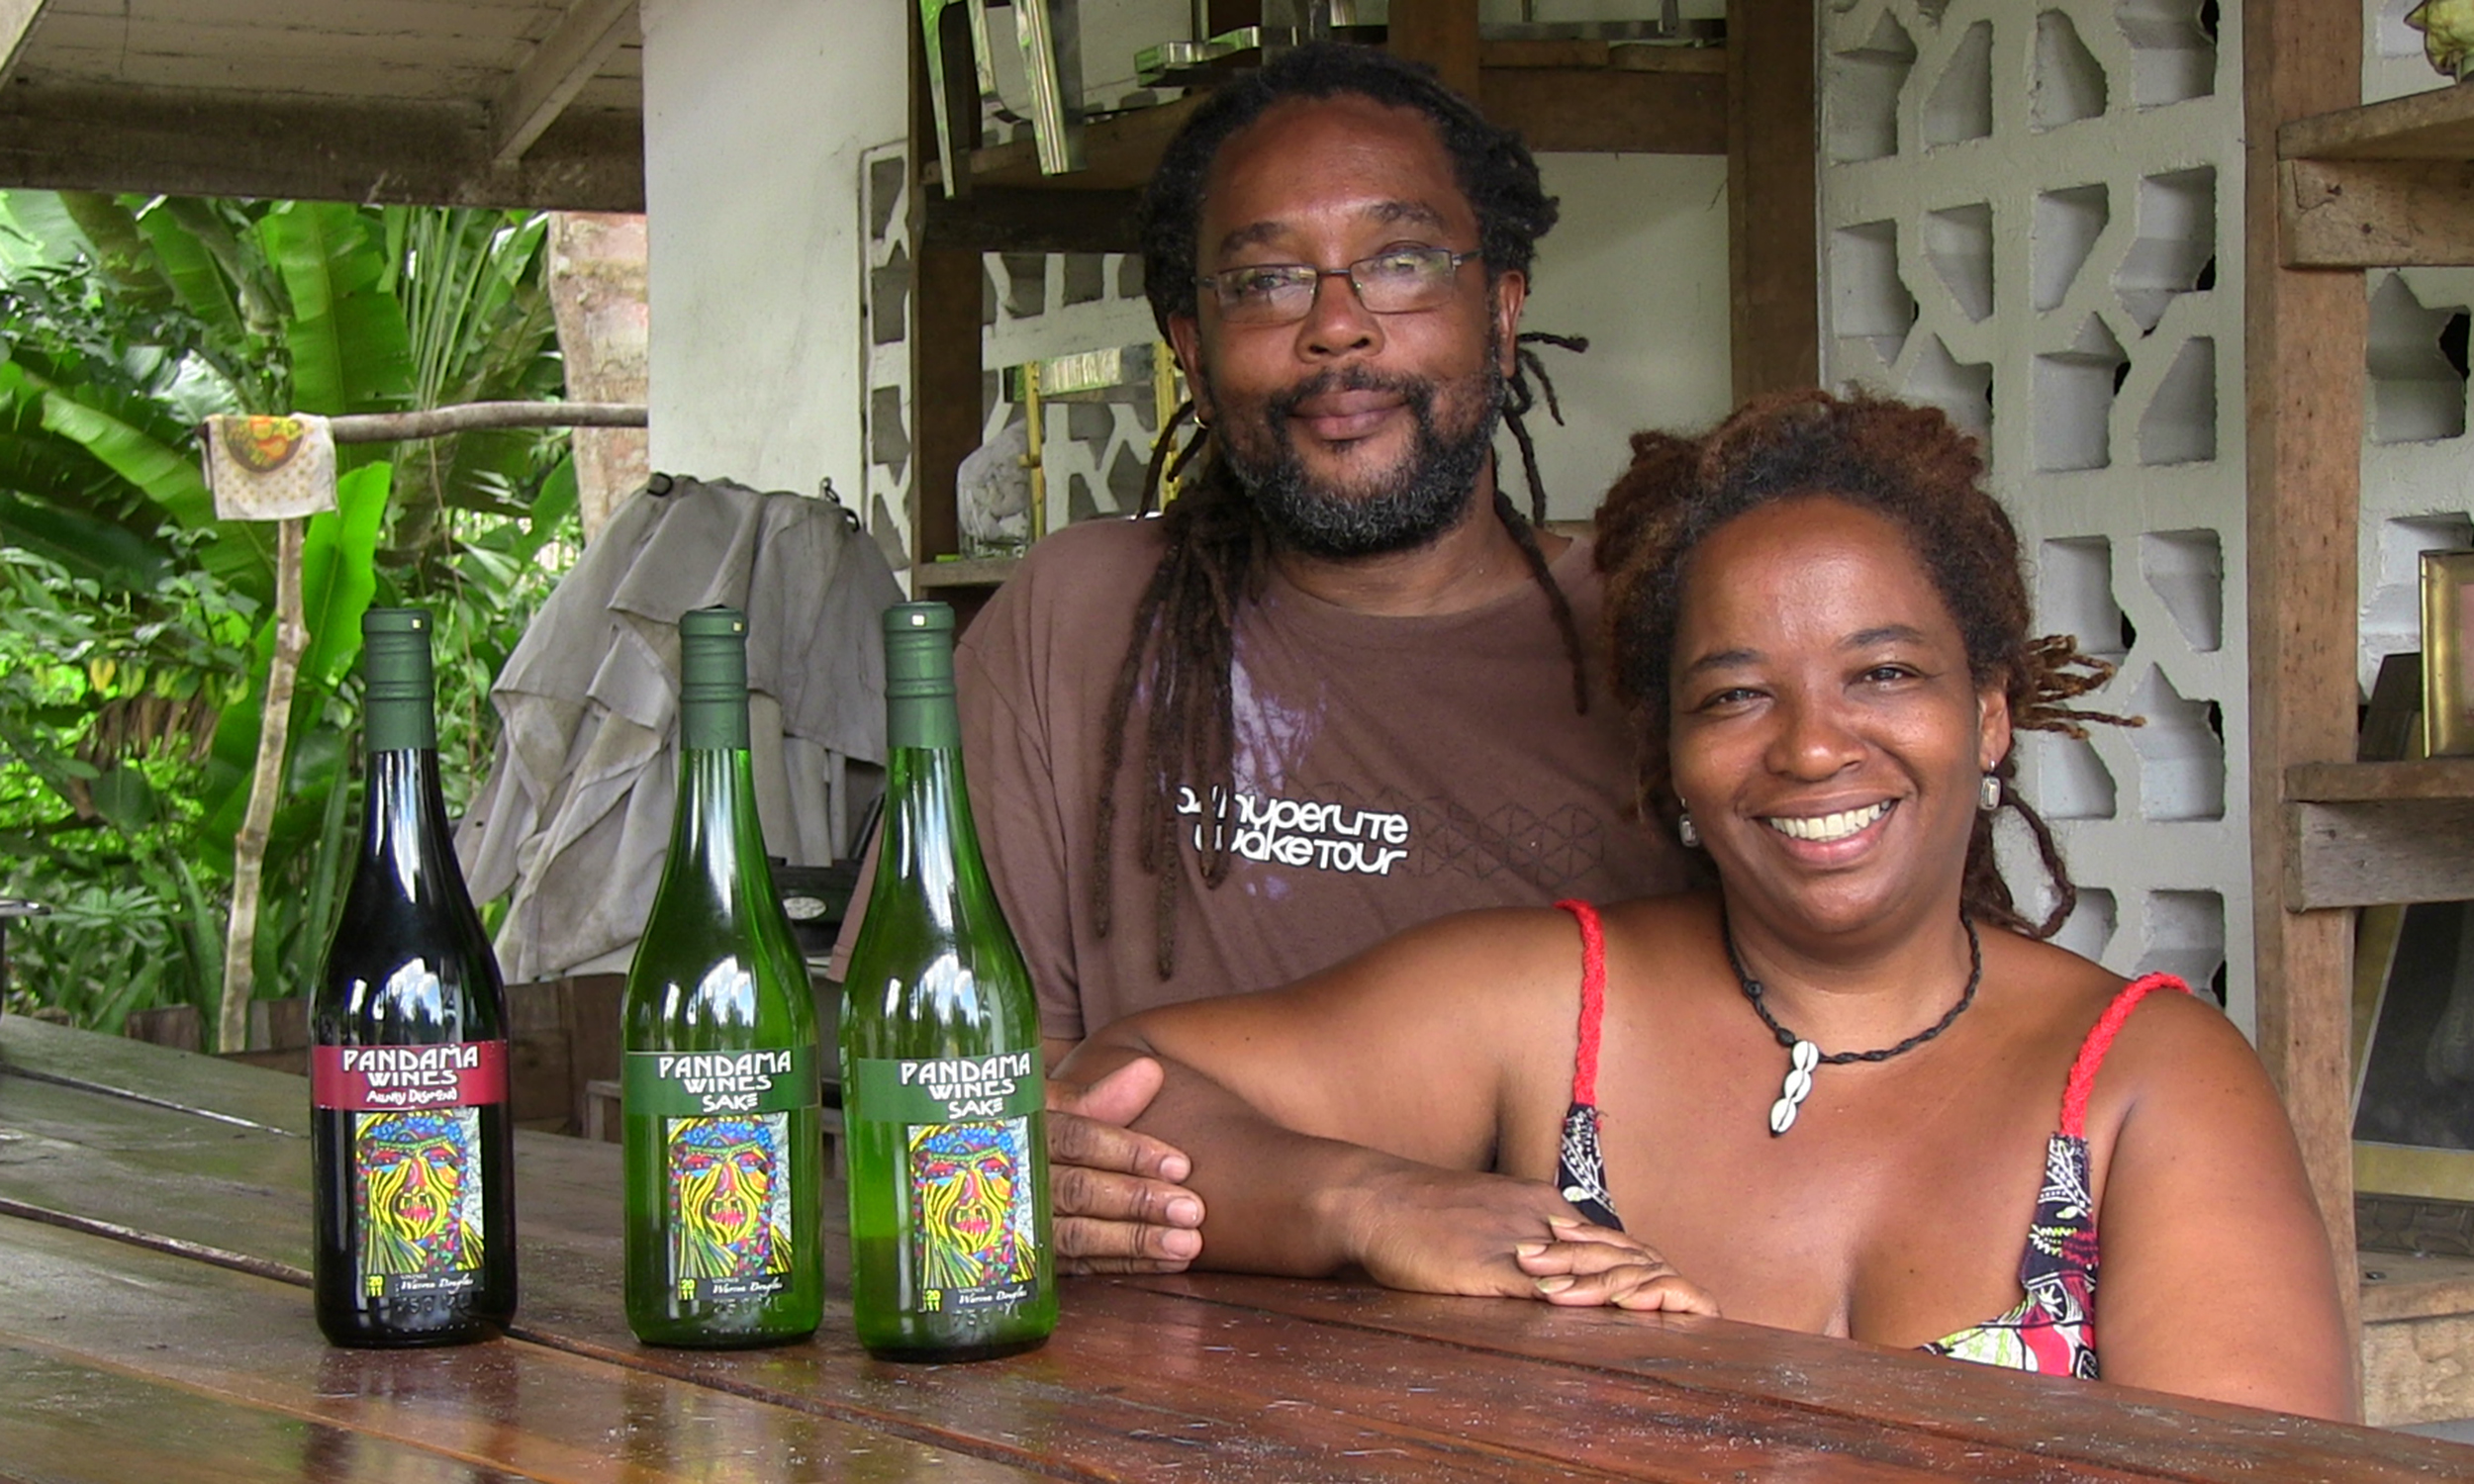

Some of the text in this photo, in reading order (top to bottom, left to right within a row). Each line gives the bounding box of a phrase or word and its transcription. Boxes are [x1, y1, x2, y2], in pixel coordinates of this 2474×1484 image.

[341, 1045, 479, 1072] PANDAMA
[658, 1050, 792, 1079] PANDAMA
[901, 1052, 1031, 1086] PANDAMA
[366, 1068, 459, 1087] WINES
[683, 1073, 773, 1094] WINES
[927, 1077, 1016, 1101] WINES
[702, 1092, 759, 1114] SAKE
[947, 1096, 1004, 1121] SAKE
